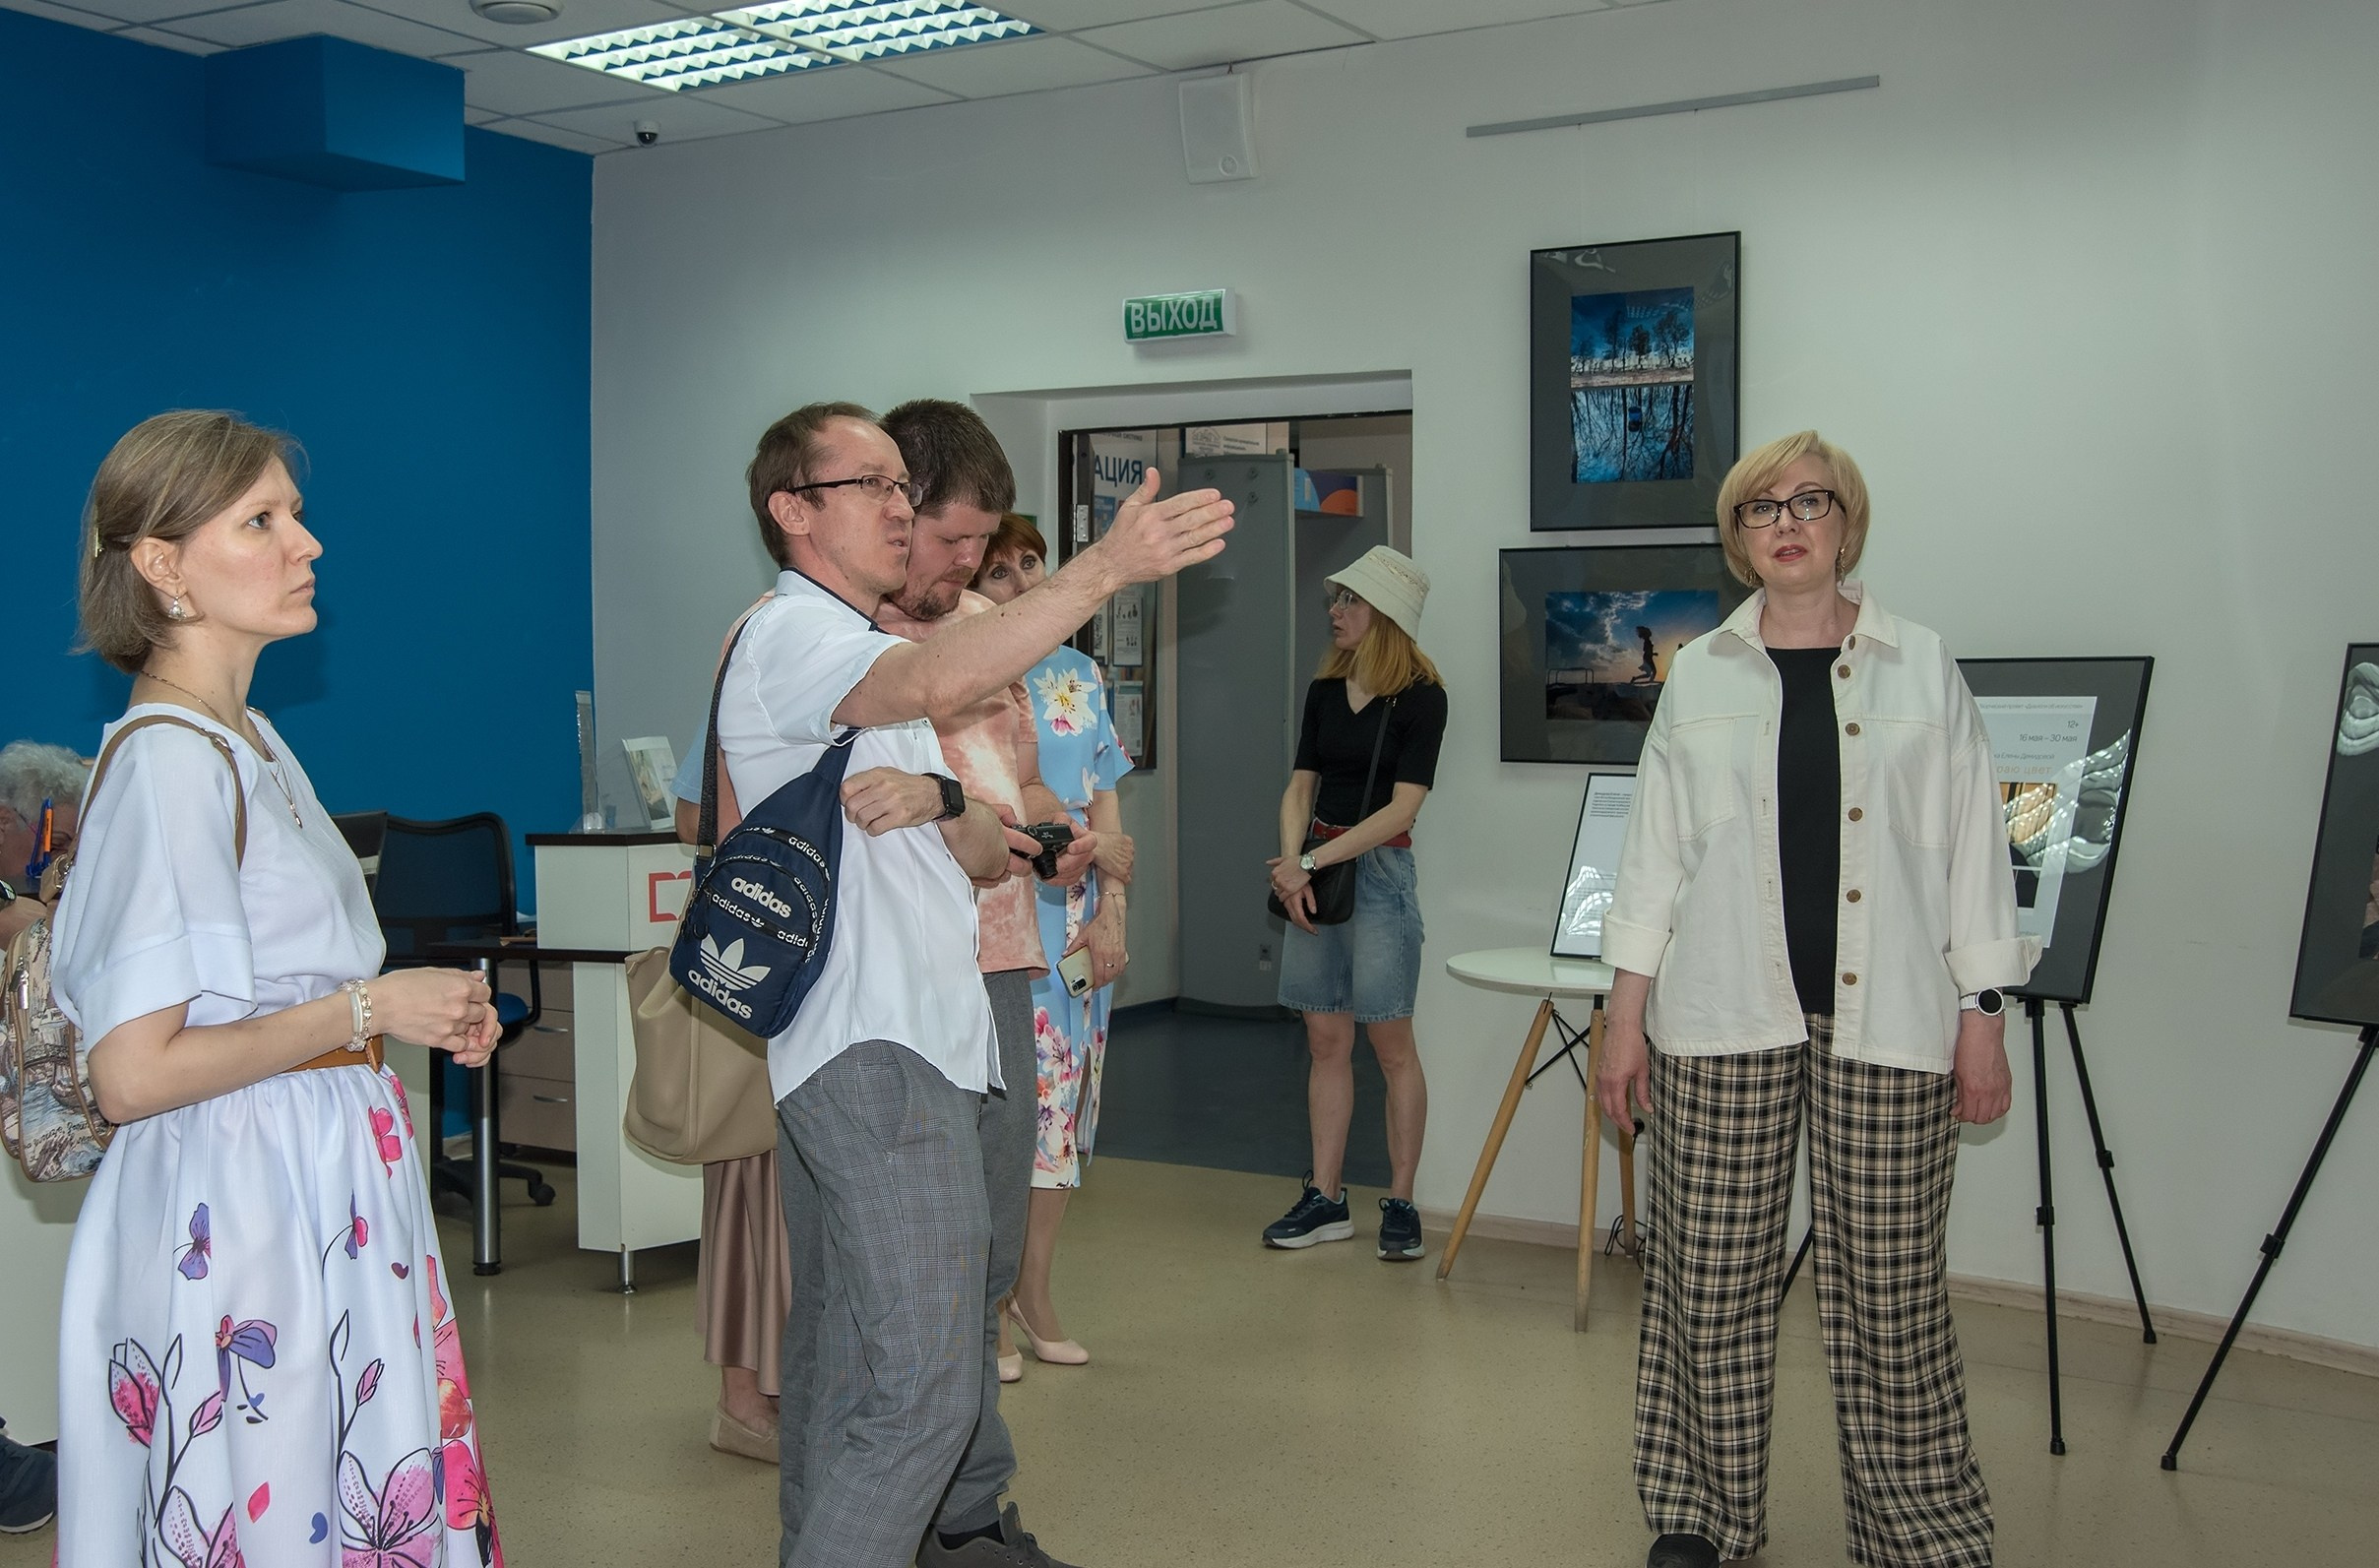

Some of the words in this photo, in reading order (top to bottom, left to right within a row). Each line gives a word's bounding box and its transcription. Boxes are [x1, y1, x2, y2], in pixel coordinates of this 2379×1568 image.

[1132, 295, 1218, 334] ВЫХОД
[2049, 733, 2061, 742] 30
[2067, 720, 2079, 728] 12+
[788, 836, 826, 868] adidas
[712, 893, 751, 922] adidas
[730, 876, 792, 919] adidas
[793, 876, 818, 918] adidas
[687, 969, 753, 1020] adidas
